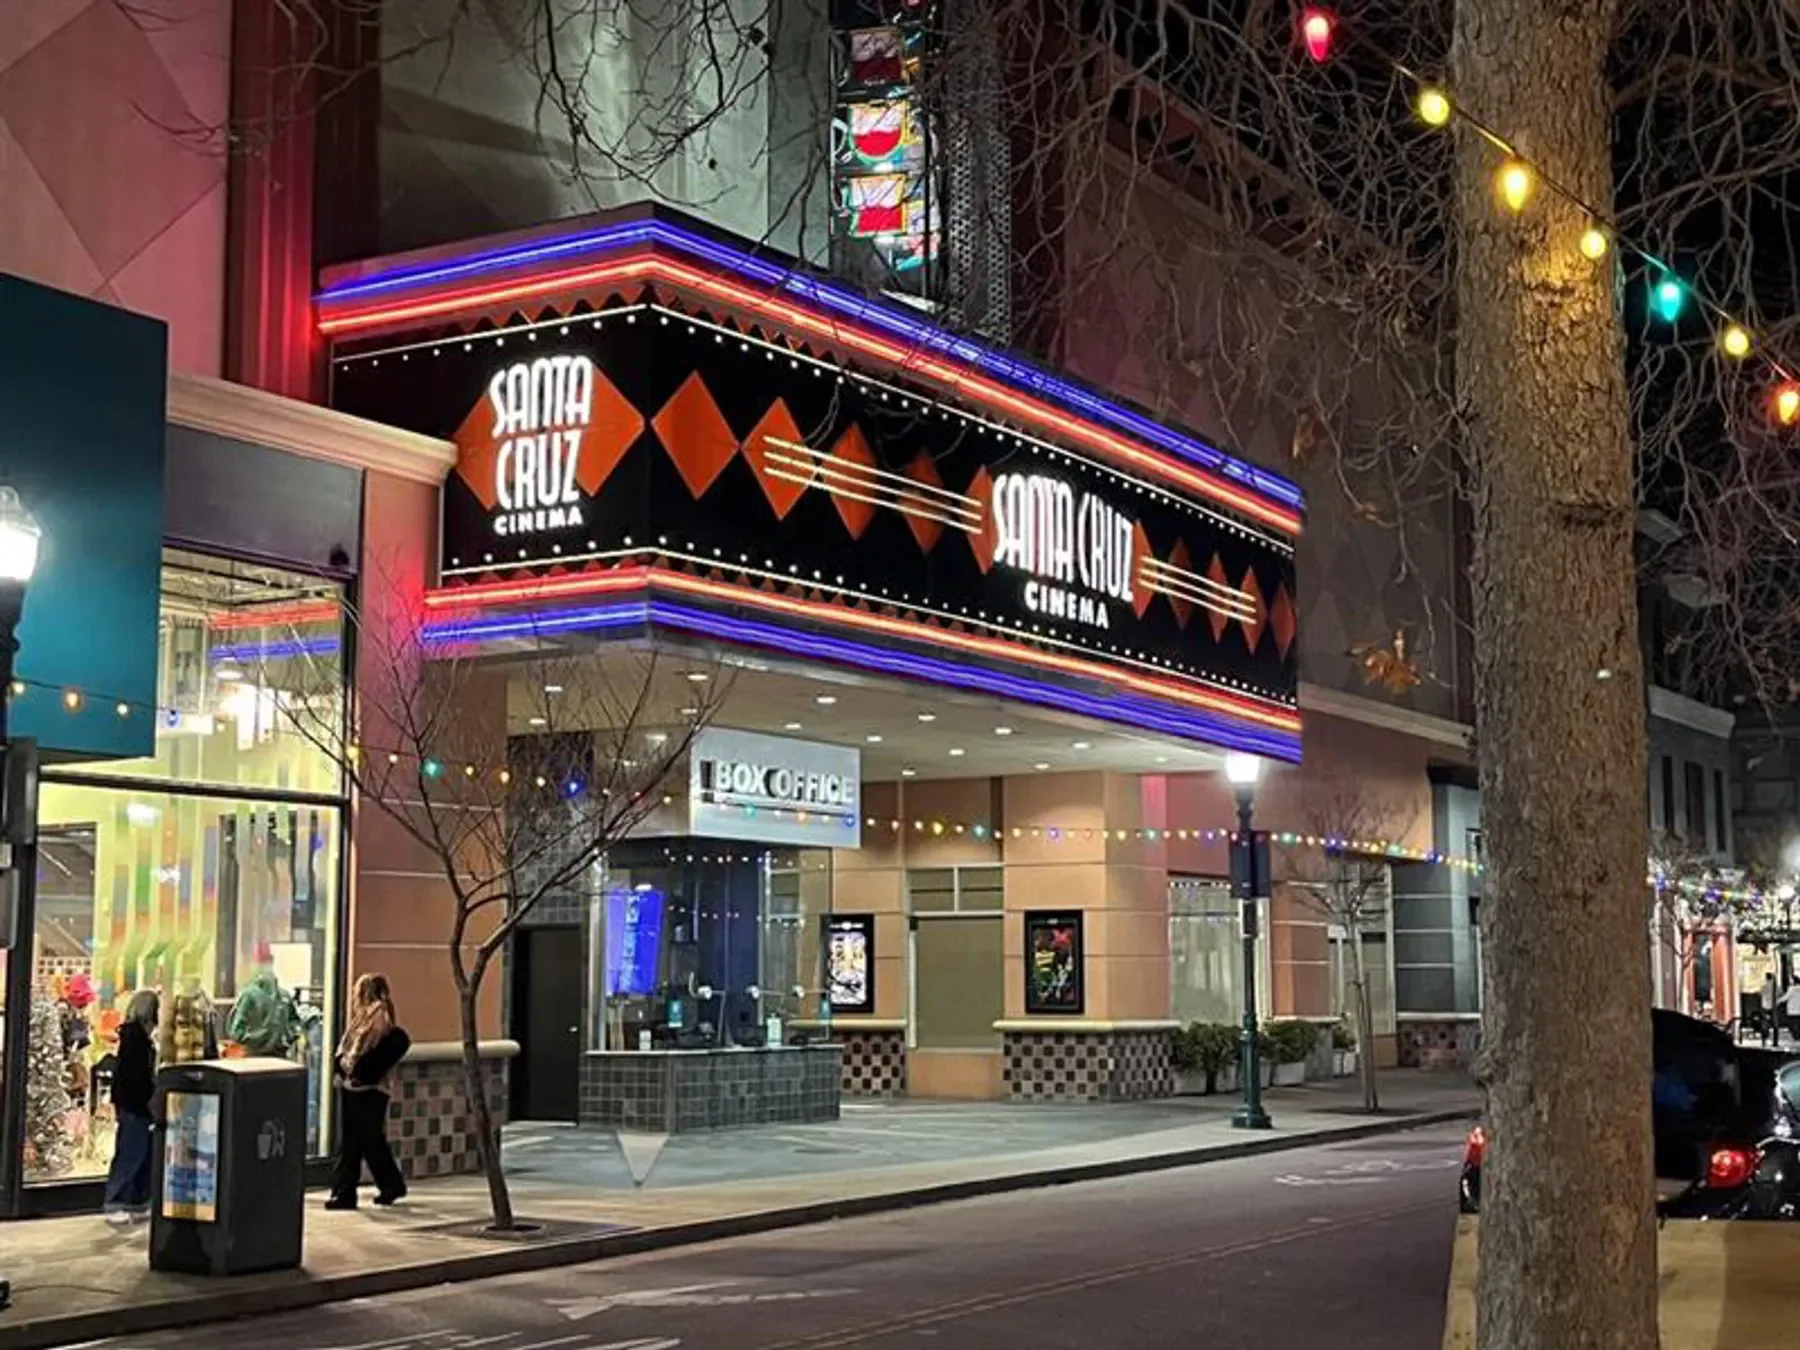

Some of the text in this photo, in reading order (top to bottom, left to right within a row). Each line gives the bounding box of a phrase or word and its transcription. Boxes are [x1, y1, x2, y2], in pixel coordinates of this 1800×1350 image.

[489, 355, 593, 438] SANTA
[496, 429, 582, 510] CRUZ
[494, 506, 583, 536] CINEMA
[992, 473, 1134, 602] SANTA CRUZ
[1025, 580, 1109, 630] CINEMA
[715, 759, 856, 803] BOX OFFICE
